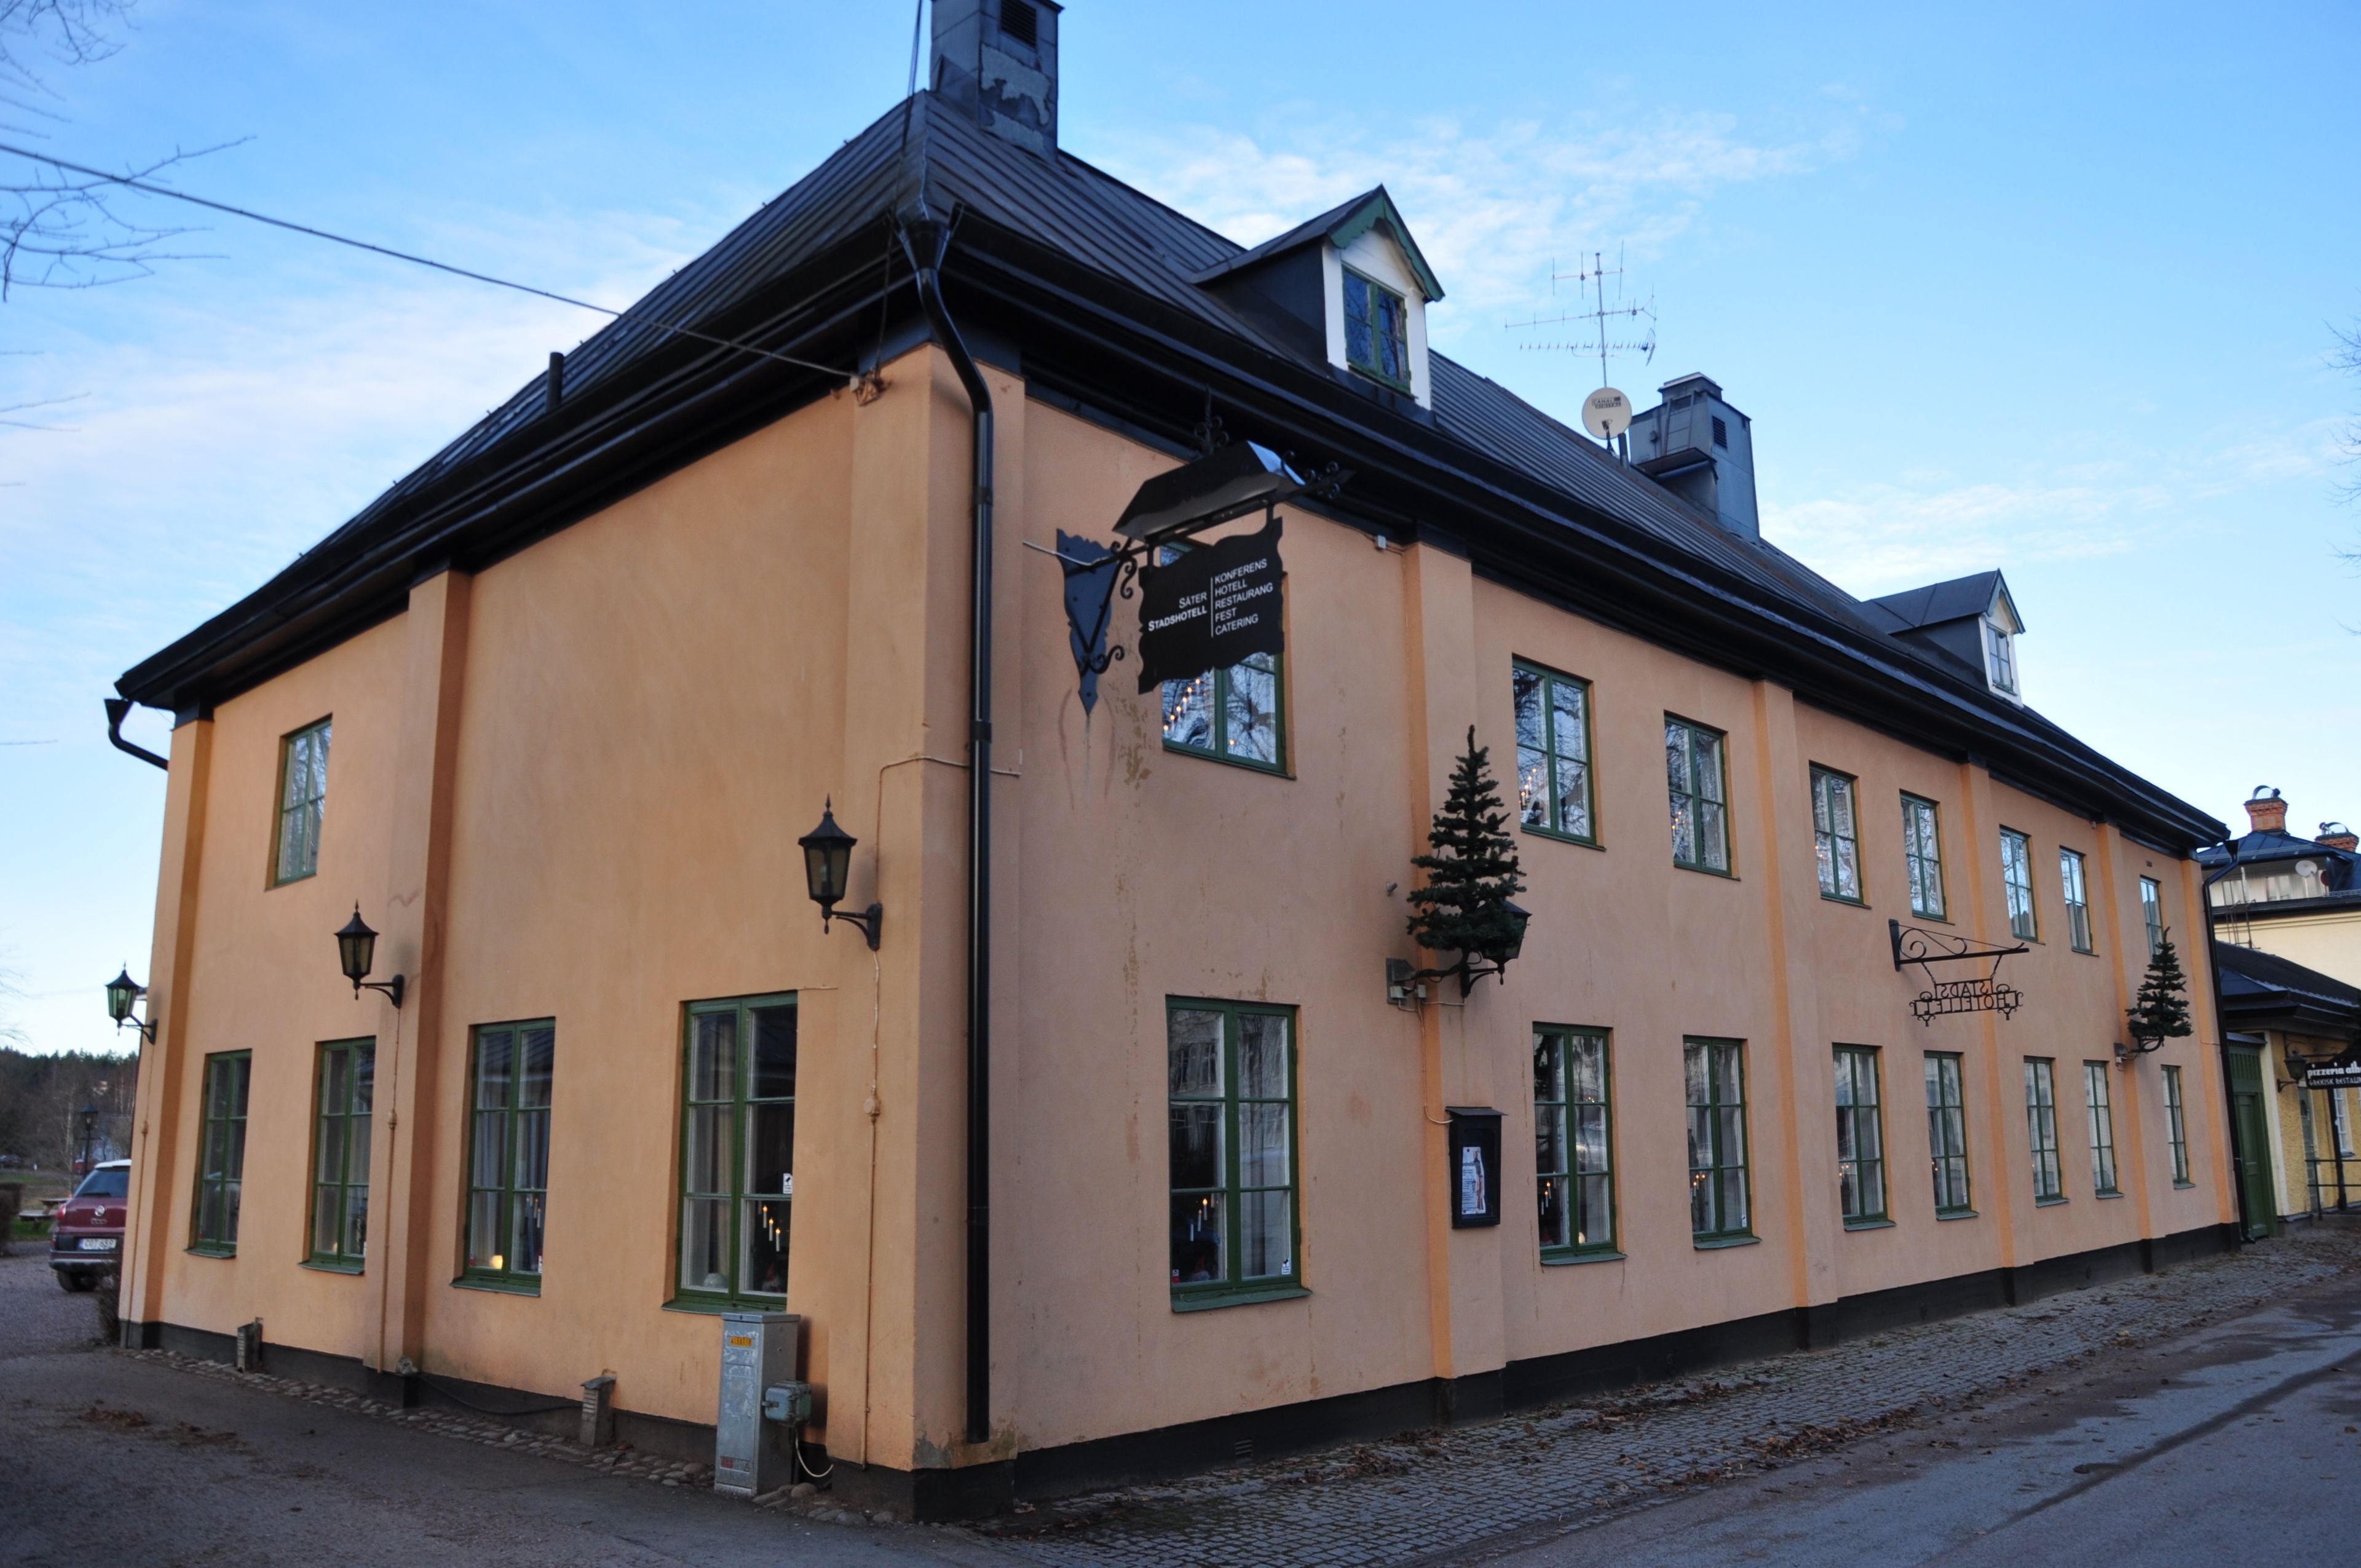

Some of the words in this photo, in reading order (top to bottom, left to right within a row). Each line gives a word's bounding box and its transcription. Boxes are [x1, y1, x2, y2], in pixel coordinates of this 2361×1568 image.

[1214, 558, 1267, 584] KONFERENS
[1214, 579, 1248, 597] HOTELL
[1214, 583, 1273, 610] RESTAURANG
[1214, 607, 1237, 622] FEST
[1214, 614, 1259, 635] CATERING
[2307, 1062, 2344, 1079] pizzeria
[2345, 1061, 2361, 1074] ath
